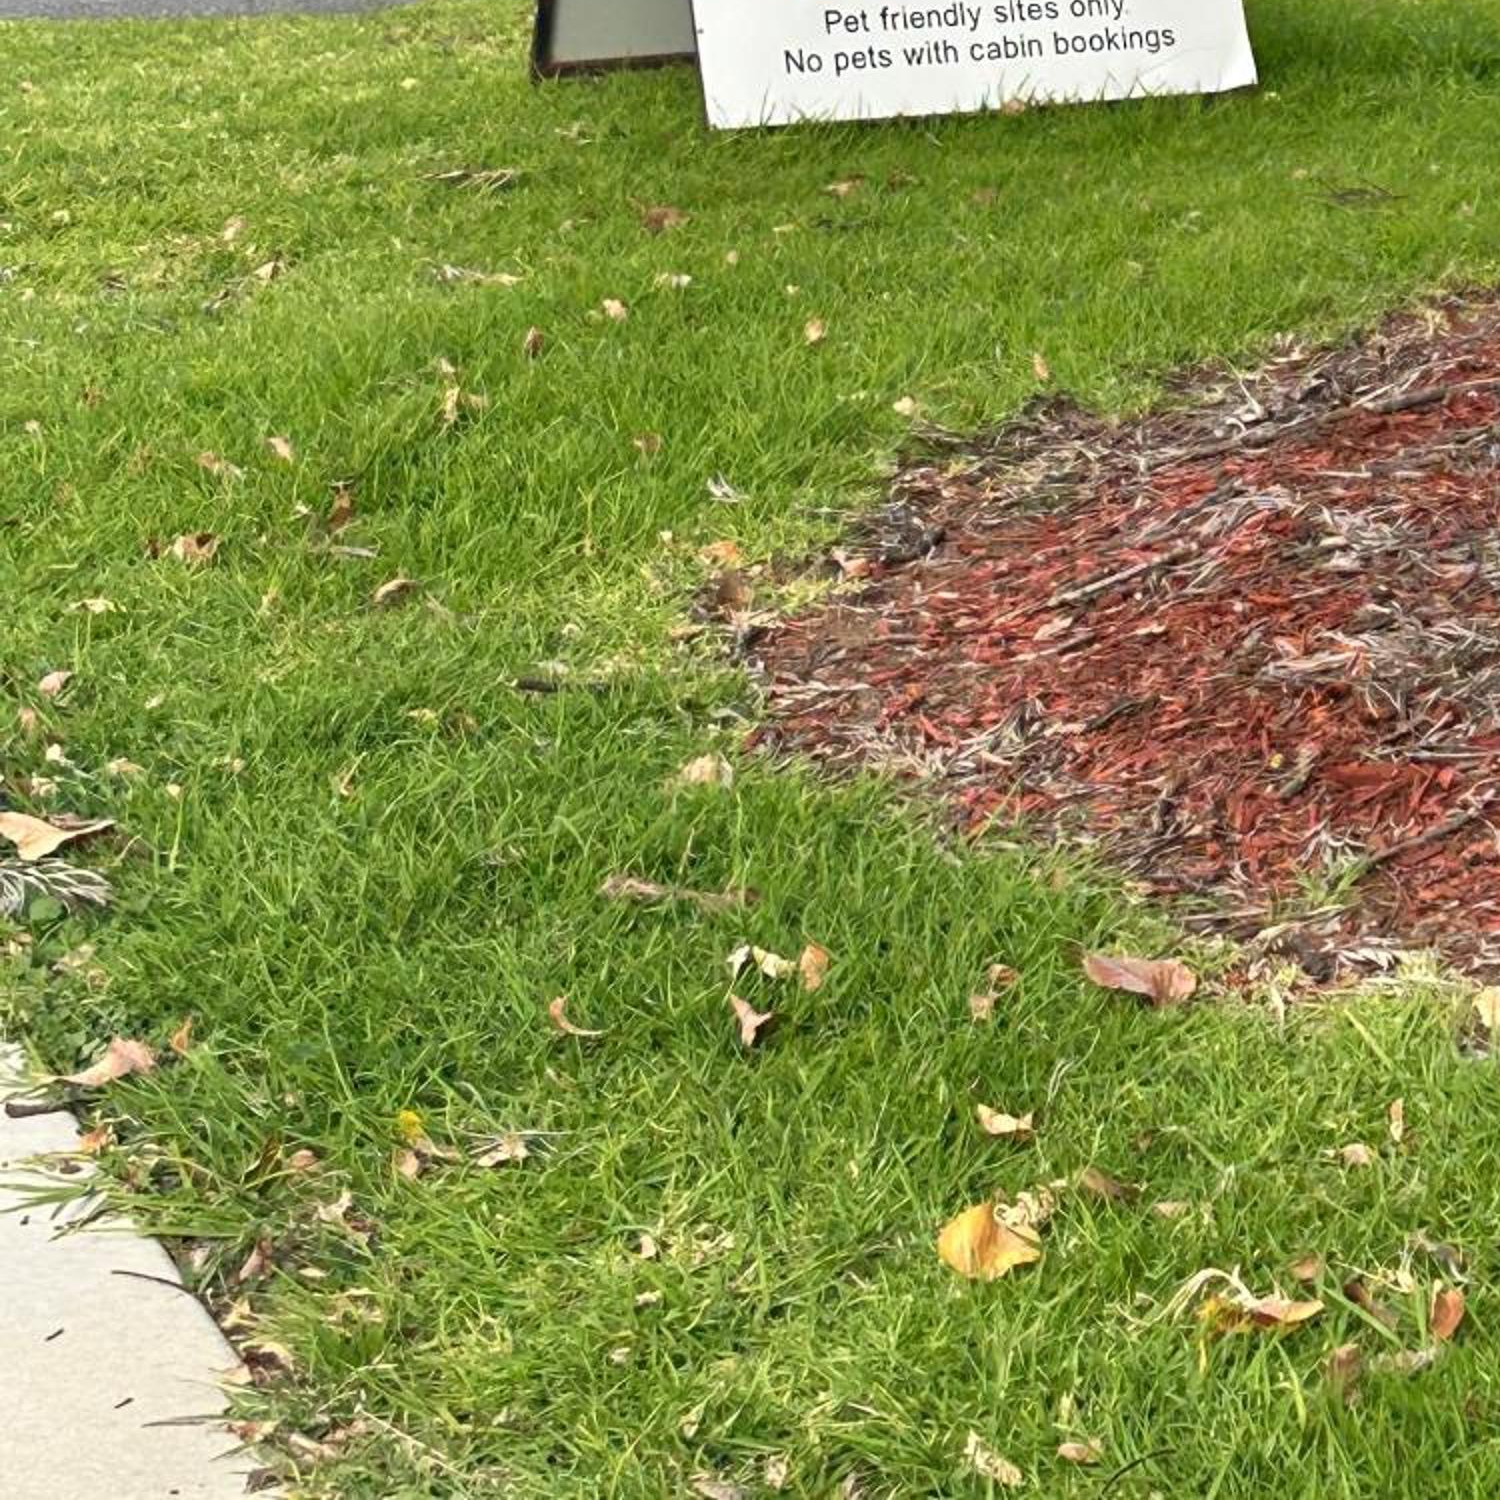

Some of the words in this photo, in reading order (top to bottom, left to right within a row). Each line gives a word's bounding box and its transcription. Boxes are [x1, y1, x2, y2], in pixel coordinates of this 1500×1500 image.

[825, 10, 870, 34] Pet
[880, 2, 981, 31] friendly
[994, 0, 1058, 23] sites
[784, 49, 822, 73] No
[834, 46, 892, 76] pets
[903, 40, 958, 66] with
[970, 35, 1042, 61] cabin
[1053, 27, 1175, 54] bookings
